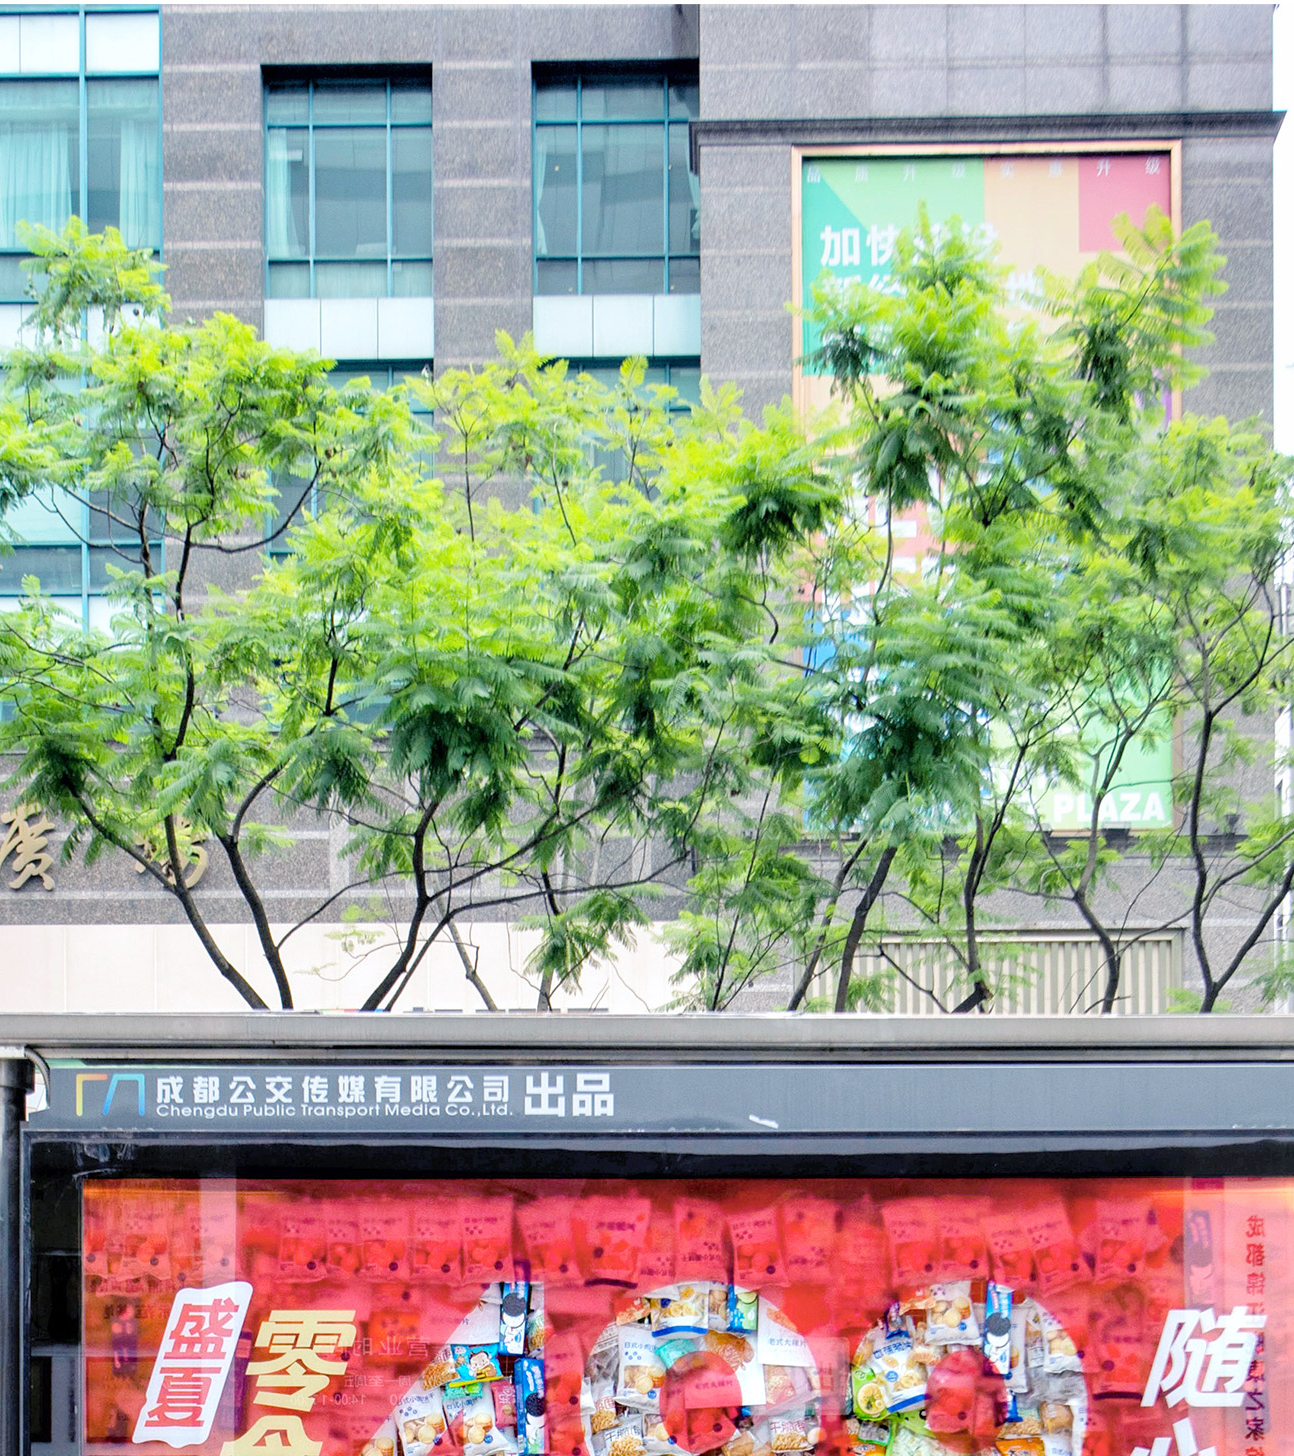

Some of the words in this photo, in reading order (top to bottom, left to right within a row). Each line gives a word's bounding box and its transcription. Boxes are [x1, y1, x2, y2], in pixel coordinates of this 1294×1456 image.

[1053, 793, 1165, 822] PLAZA
[156, 1074, 510, 1104] 成都公交传媒有限公司
[524, 1072, 615, 1117] 出品
[156, 1103, 239, 1118] Chengdu
[243, 1103, 296, 1116] Public
[301, 1103, 381, 1118] Transport
[385, 1103, 441, 1116] Media
[144, 1297, 239, 1428] 盛夏
